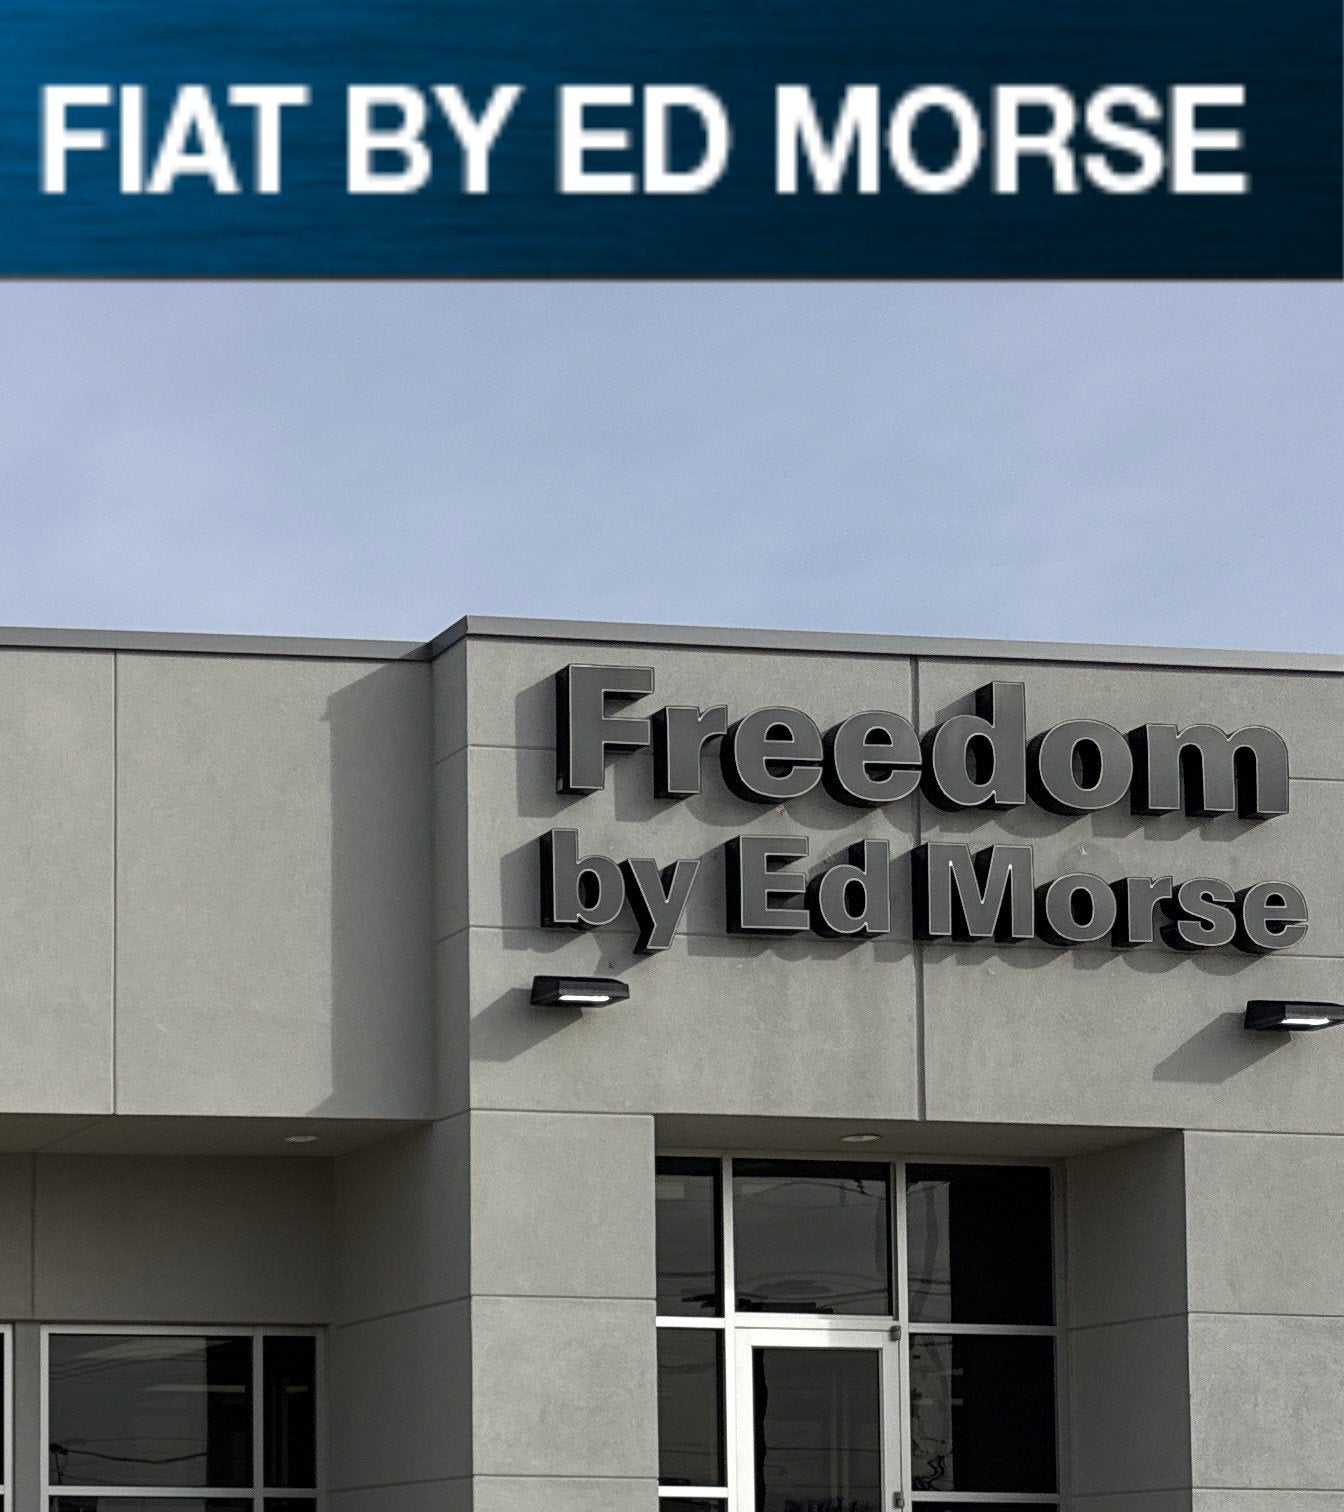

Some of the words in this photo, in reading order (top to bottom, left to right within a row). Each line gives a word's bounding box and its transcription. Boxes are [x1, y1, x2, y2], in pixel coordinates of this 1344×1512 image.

[556, 664, 1289, 819] Freedom
[540, 828, 700, 953] by
[727, 834, 891, 937] Ed
[914, 842, 1308, 953] Morse
